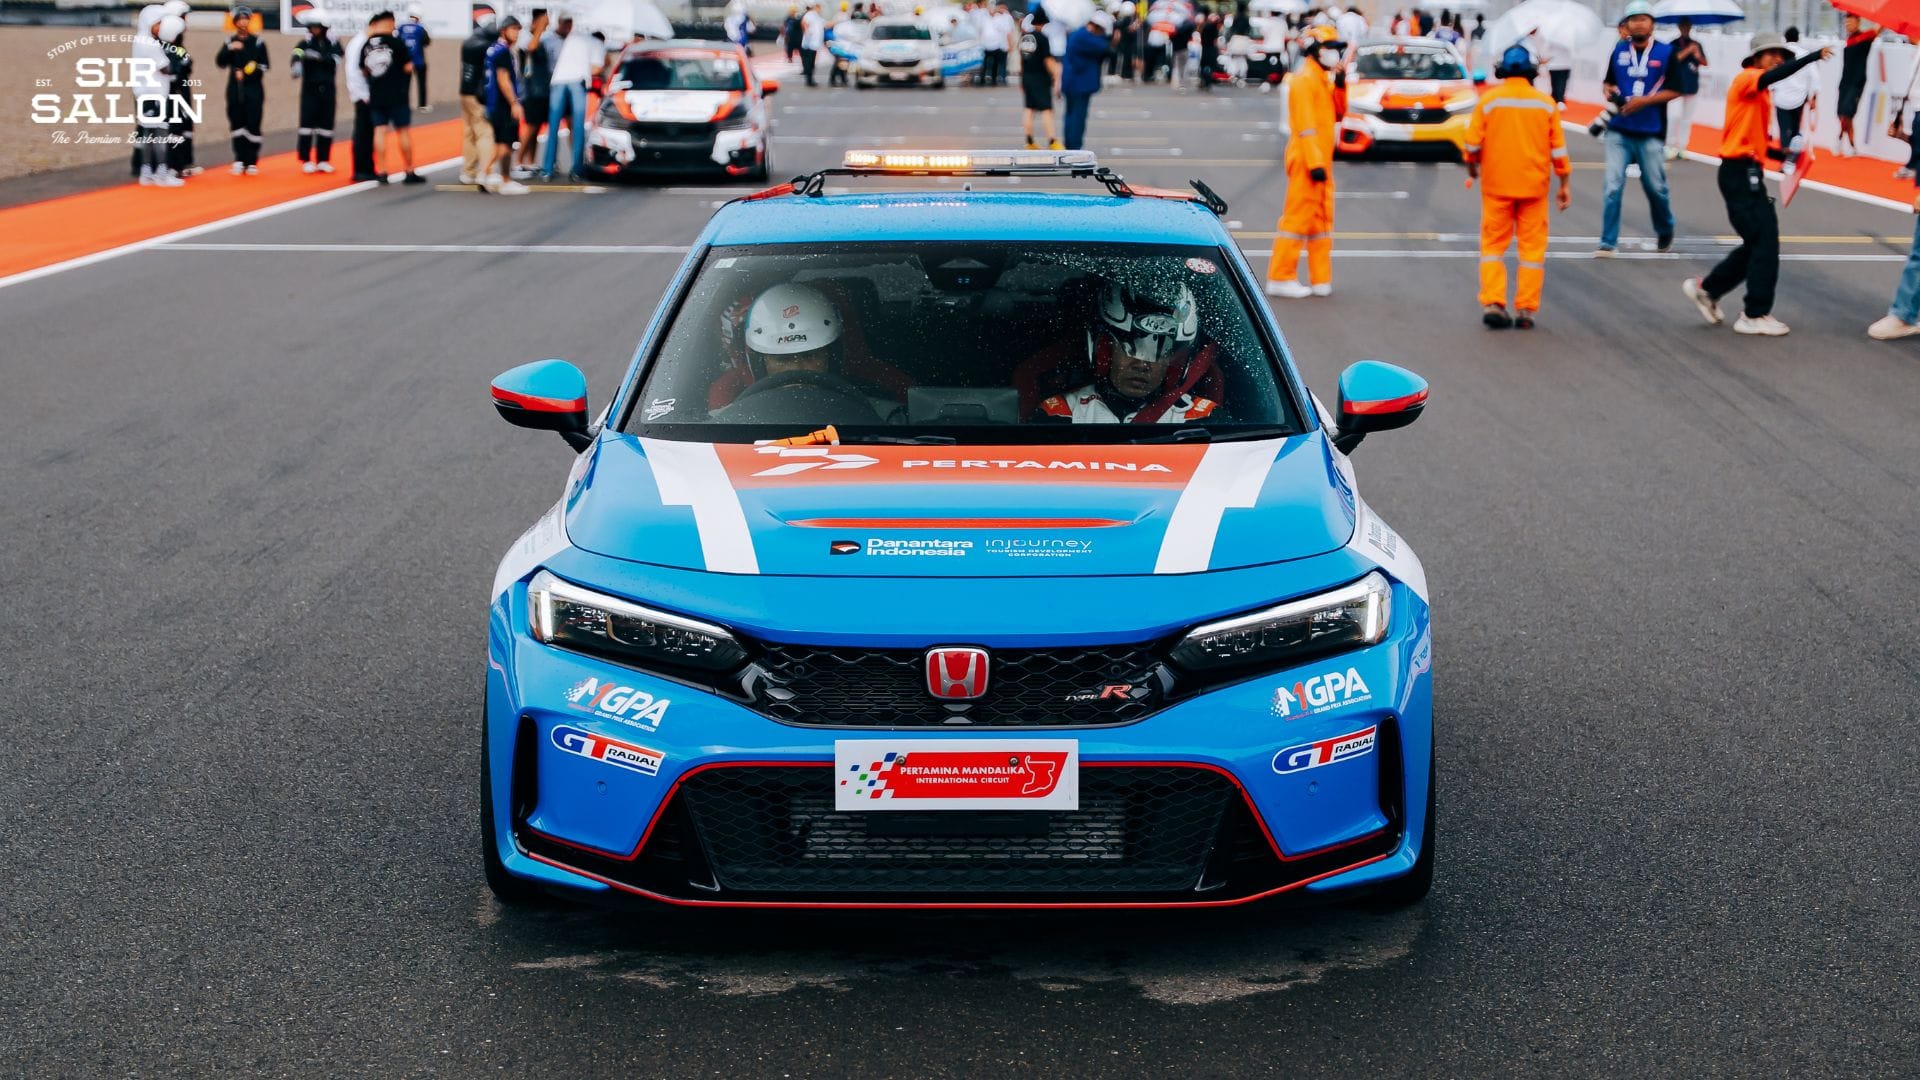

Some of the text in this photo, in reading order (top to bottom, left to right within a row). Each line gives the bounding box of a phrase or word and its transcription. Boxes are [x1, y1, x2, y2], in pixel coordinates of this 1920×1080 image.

[902, 460, 1173, 473] PERTAMINA
[867, 538, 974, 549] Danantara
[985, 539, 1093, 550] injourney
[866, 548, 966, 557] Indonesia
[1100, 684, 1132, 699] R
[563, 733, 658, 768] GT RADIAL
[1288, 737, 1374, 769] GT RADIAL
[900, 766, 1026, 775] PERTAMINA MANDALIKA
